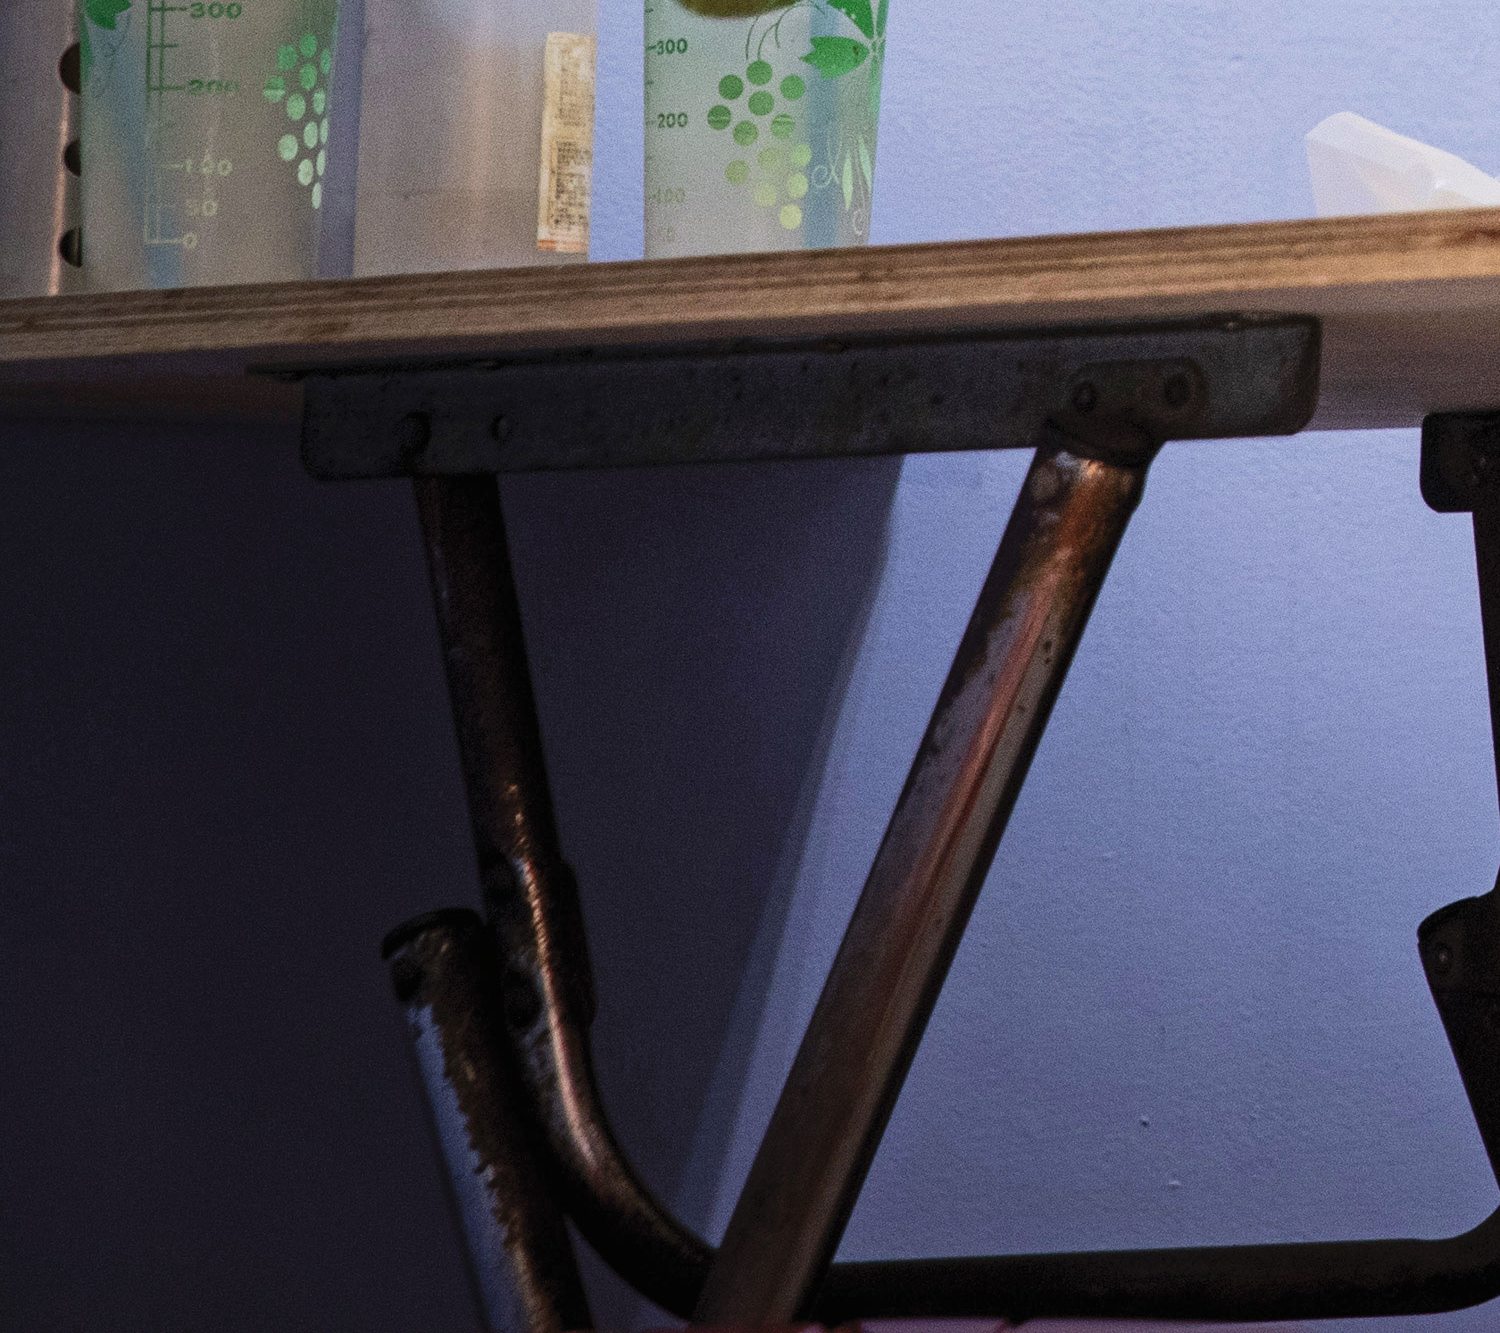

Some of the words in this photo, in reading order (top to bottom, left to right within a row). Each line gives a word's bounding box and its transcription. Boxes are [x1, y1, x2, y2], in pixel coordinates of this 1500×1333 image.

[189, 1, 243, 20] 300
[656, 38, 689, 55] 300
[656, 113, 689, 129] 200
